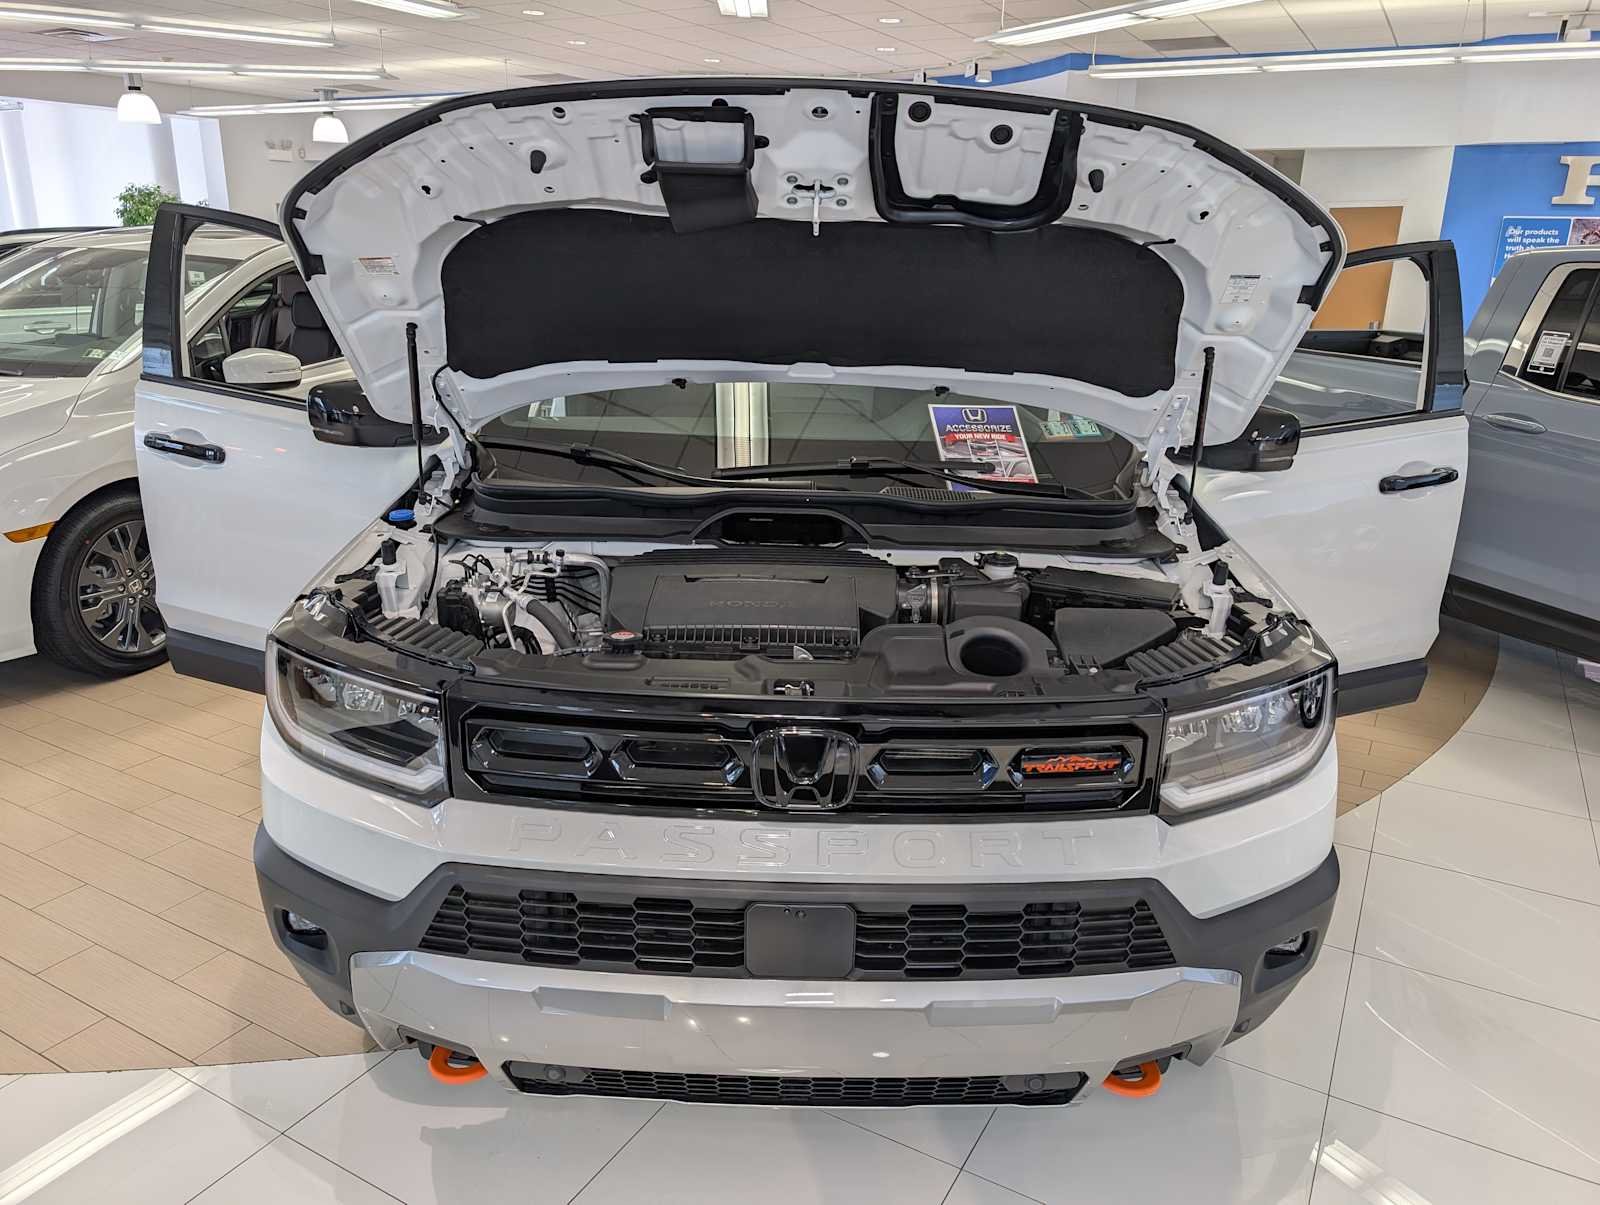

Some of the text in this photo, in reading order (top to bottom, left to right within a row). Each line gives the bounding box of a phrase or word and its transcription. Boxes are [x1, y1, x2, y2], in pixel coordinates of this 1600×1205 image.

[1508, 228, 1559, 237] Our products
[1507, 236, 1560, 245] will speak the
[946, 424, 1013, 433] ACCESSORIZE
[991, 433, 1006, 441] RIDE
[1022, 758, 1121, 774] TRAILSPORT
[507, 814, 1097, 868] PASSPORT
